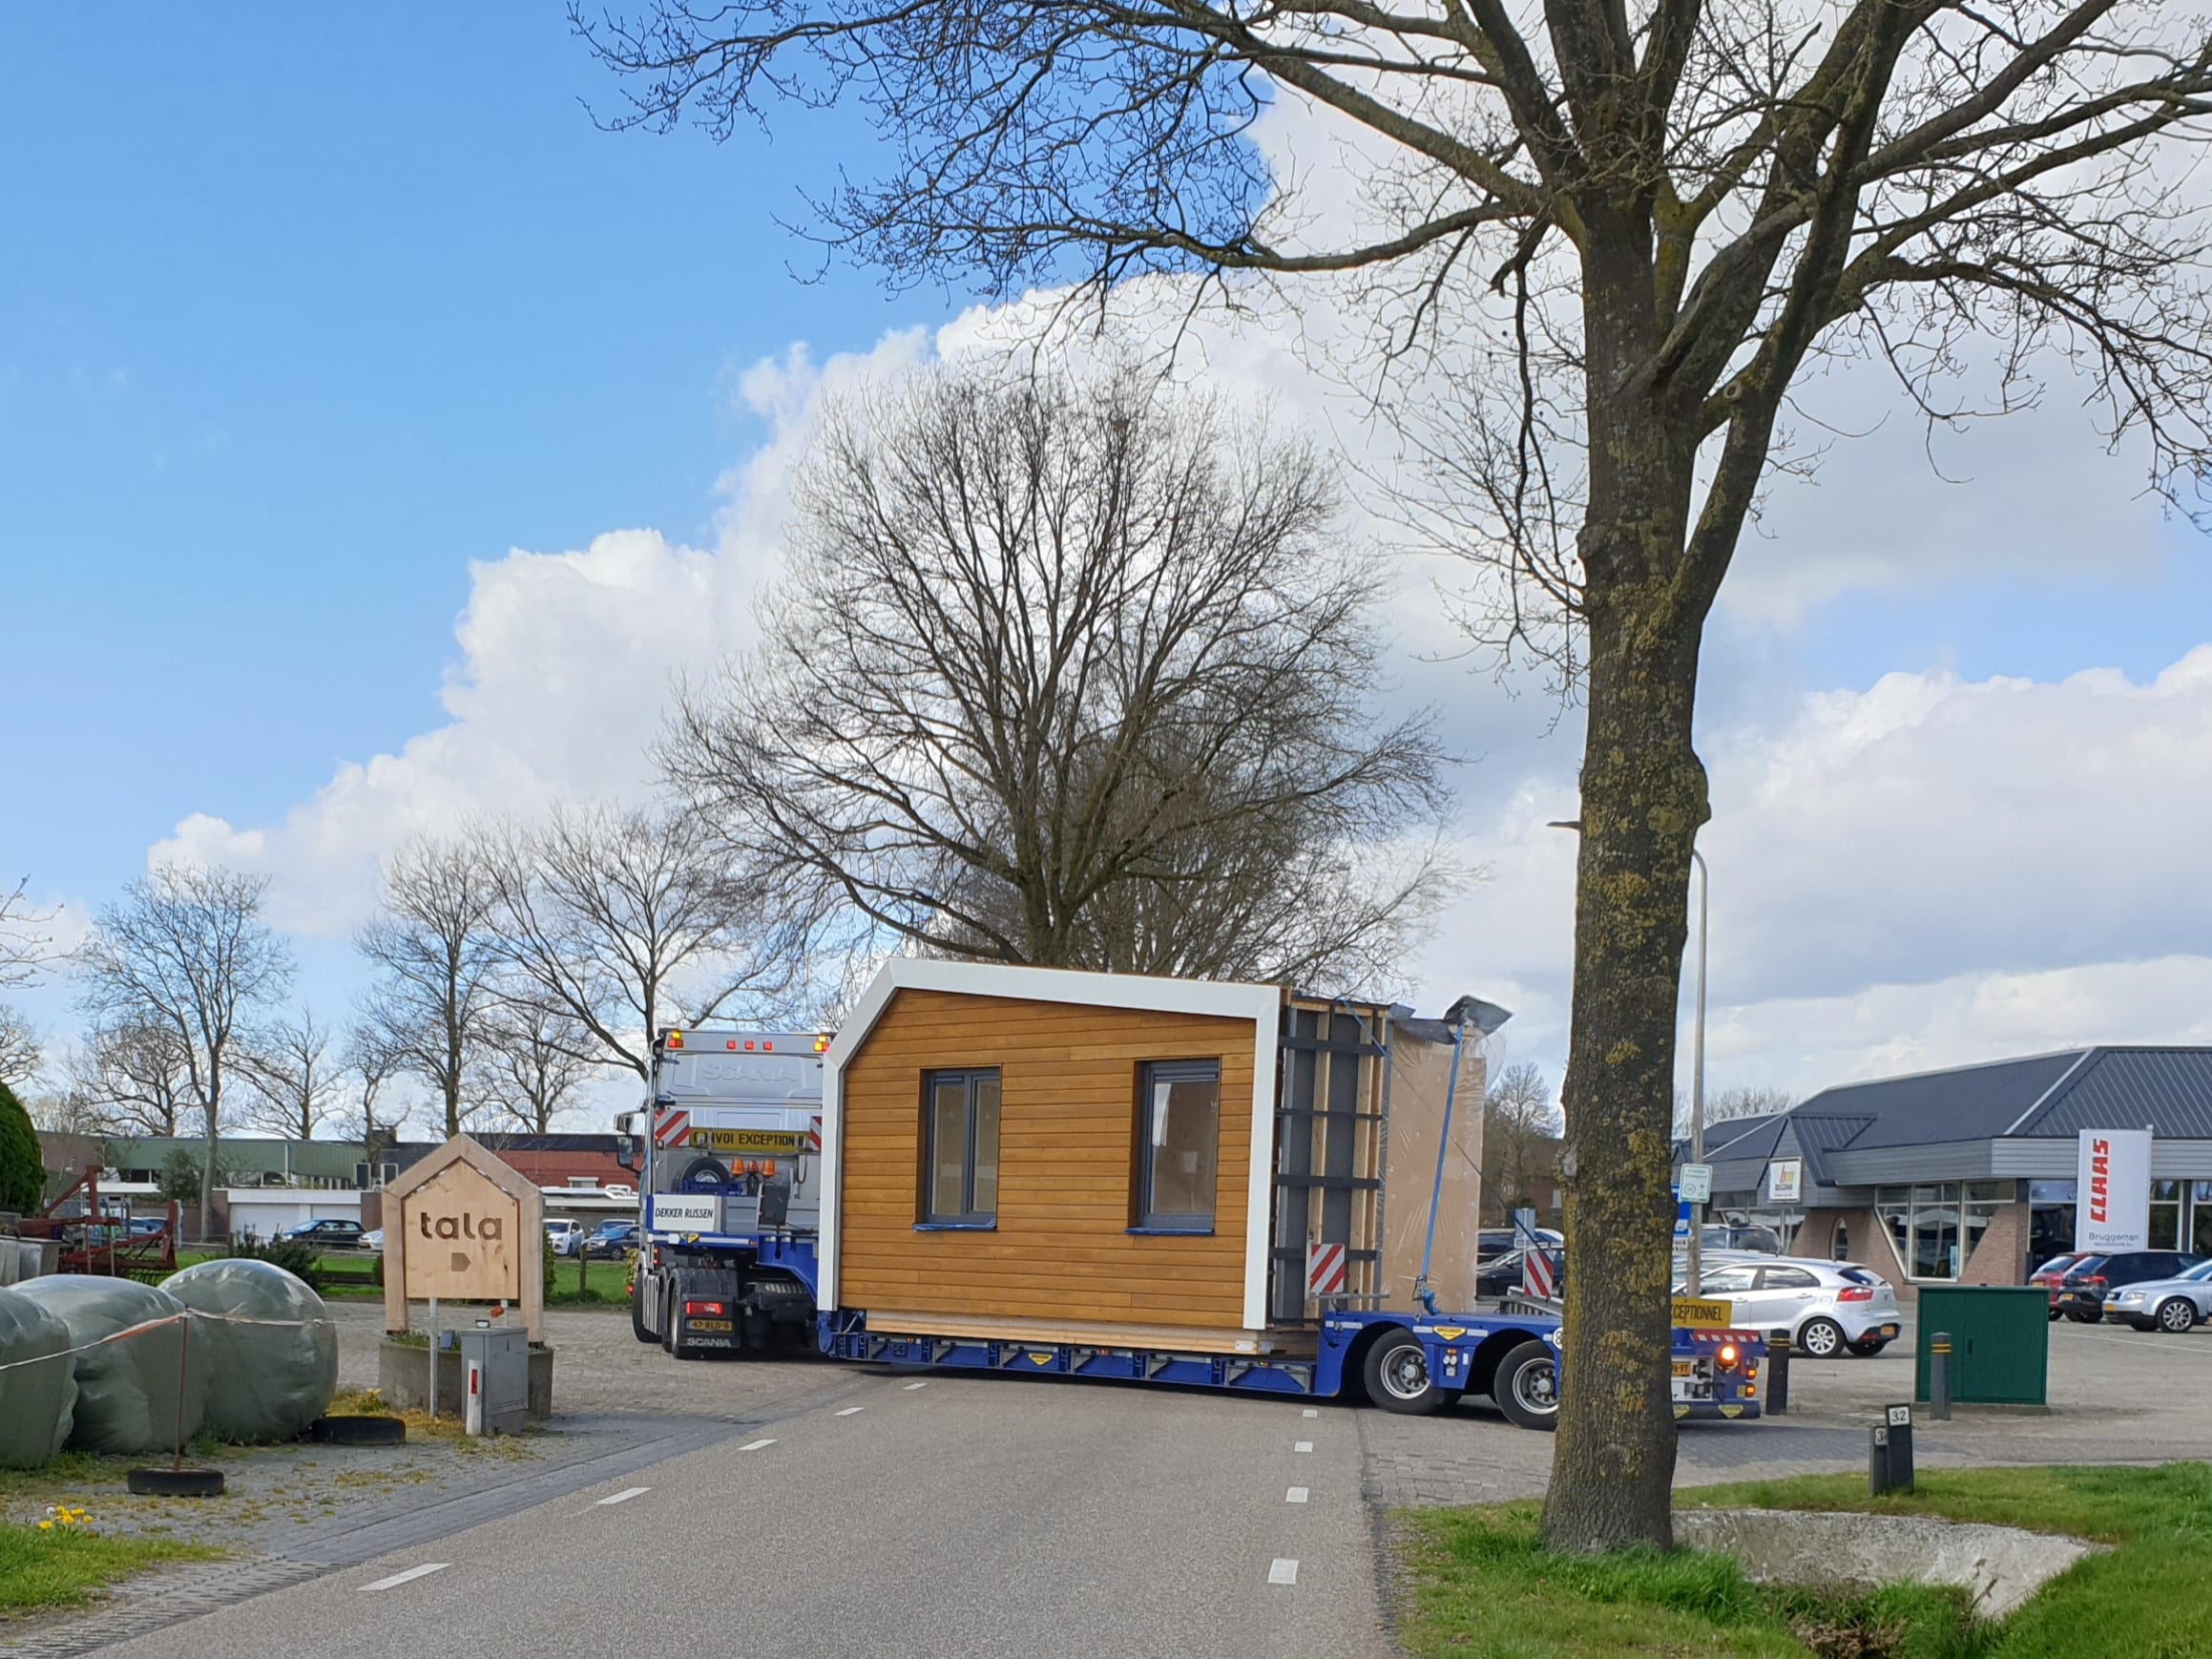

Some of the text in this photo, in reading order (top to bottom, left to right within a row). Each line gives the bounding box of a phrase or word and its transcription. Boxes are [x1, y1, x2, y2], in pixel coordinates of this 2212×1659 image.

[701, 1062, 798, 1082] SCANIA
[2090, 1138, 2109, 1223] CLAAS
[655, 1208, 683, 1218] DEKKER
[421, 1211, 502, 1240] tala
[1671, 1304, 1723, 1321] CEPTIONNEL
[687, 1337, 732, 1348] SCANIA
[1892, 1410, 1907, 1422] 32
